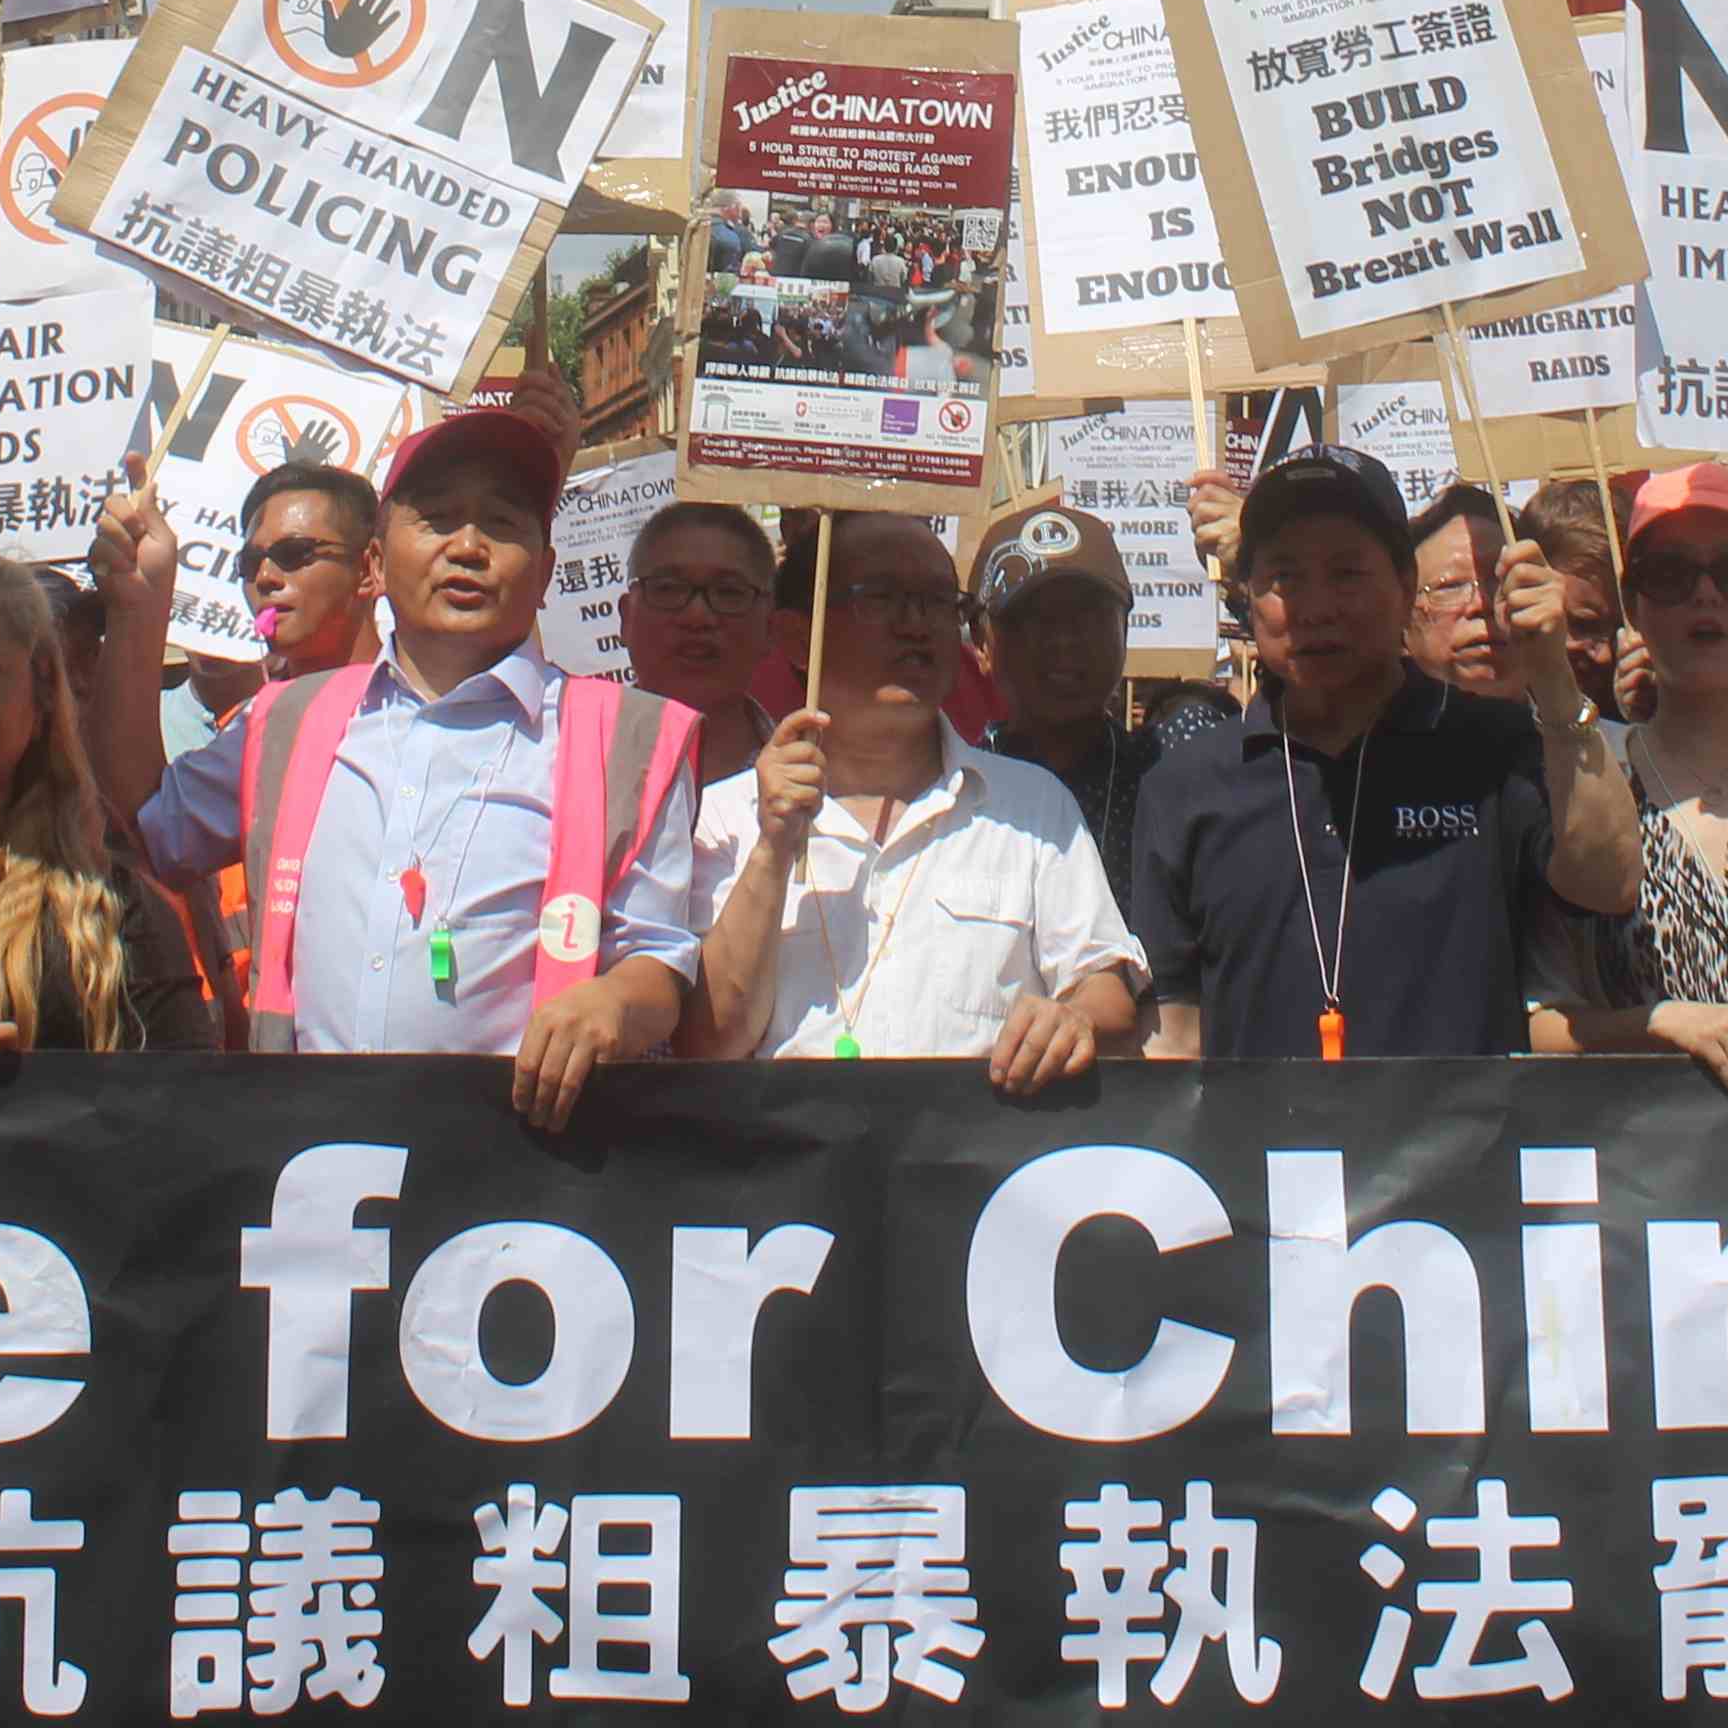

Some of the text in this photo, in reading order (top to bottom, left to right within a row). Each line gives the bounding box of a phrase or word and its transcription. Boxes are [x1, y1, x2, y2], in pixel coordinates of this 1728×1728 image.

[1261, 3, 1293, 17] HOUR
[1037, 14, 1112, 72] Justice
[1246, 2, 1498, 93] 放寬勞工簽證
[732, 70, 828, 132] Justice
[792, 93, 993, 129] for CHINATOWN
[1312, 76, 1470, 143] BUILD
[191, 65, 512, 231] HEAVY HANDED
[761, 142, 793, 154] HOUR
[798, 145, 837, 157] STRIKE
[843, 147, 860, 158] TO
[863, 149, 916, 162] PROTEST
[921, 152, 973, 166] AGAINST
[778, 156, 853, 170] IMMIGRATION
[905, 164, 940, 176] RAIDS
[1312, 127, 1501, 197] Bridges
[1065, 152, 1200, 196] ENOU
[162, 118, 484, 297] POLICING
[1149, 207, 1194, 241] IS
[1361, 178, 1476, 238] NOT
[1305, 208, 1563, 301] Brexit Wall
[115, 190, 450, 378] 抗議粗暴執法
[1528, 355, 1611, 382] RAIDS
[1351, 395, 1407, 439] Justice
[1122, 521, 1178, 536] MORE
[580, 601, 613, 622] NO
[1396, 805, 1477, 831] BOSS
[239, 1141, 834, 1443] for
